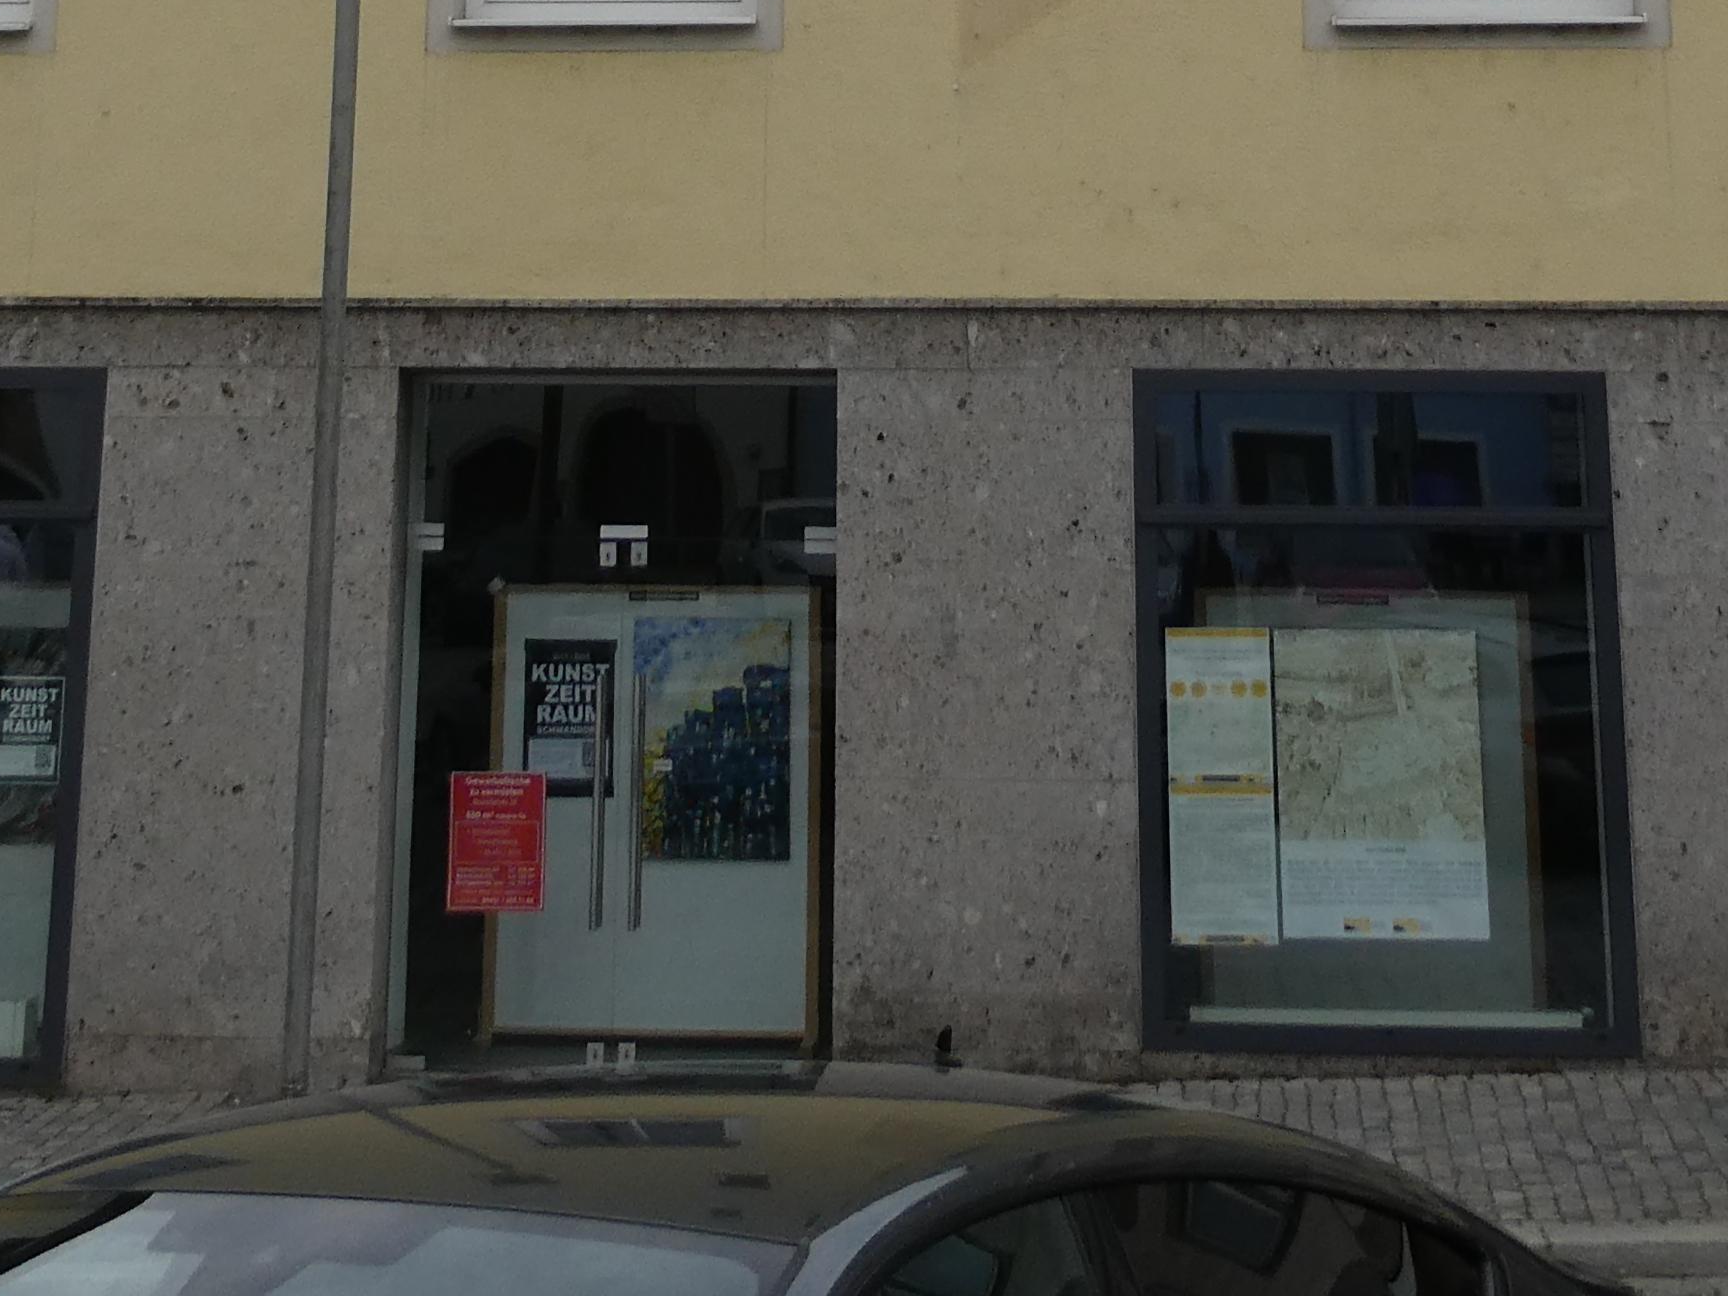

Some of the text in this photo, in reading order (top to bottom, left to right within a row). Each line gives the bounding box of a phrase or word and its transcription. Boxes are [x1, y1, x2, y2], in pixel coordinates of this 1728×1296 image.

[531, 663, 610, 683] KUNST
[0, 688, 59, 702] KUNST
[2, 719, 53, 734] RAUM
